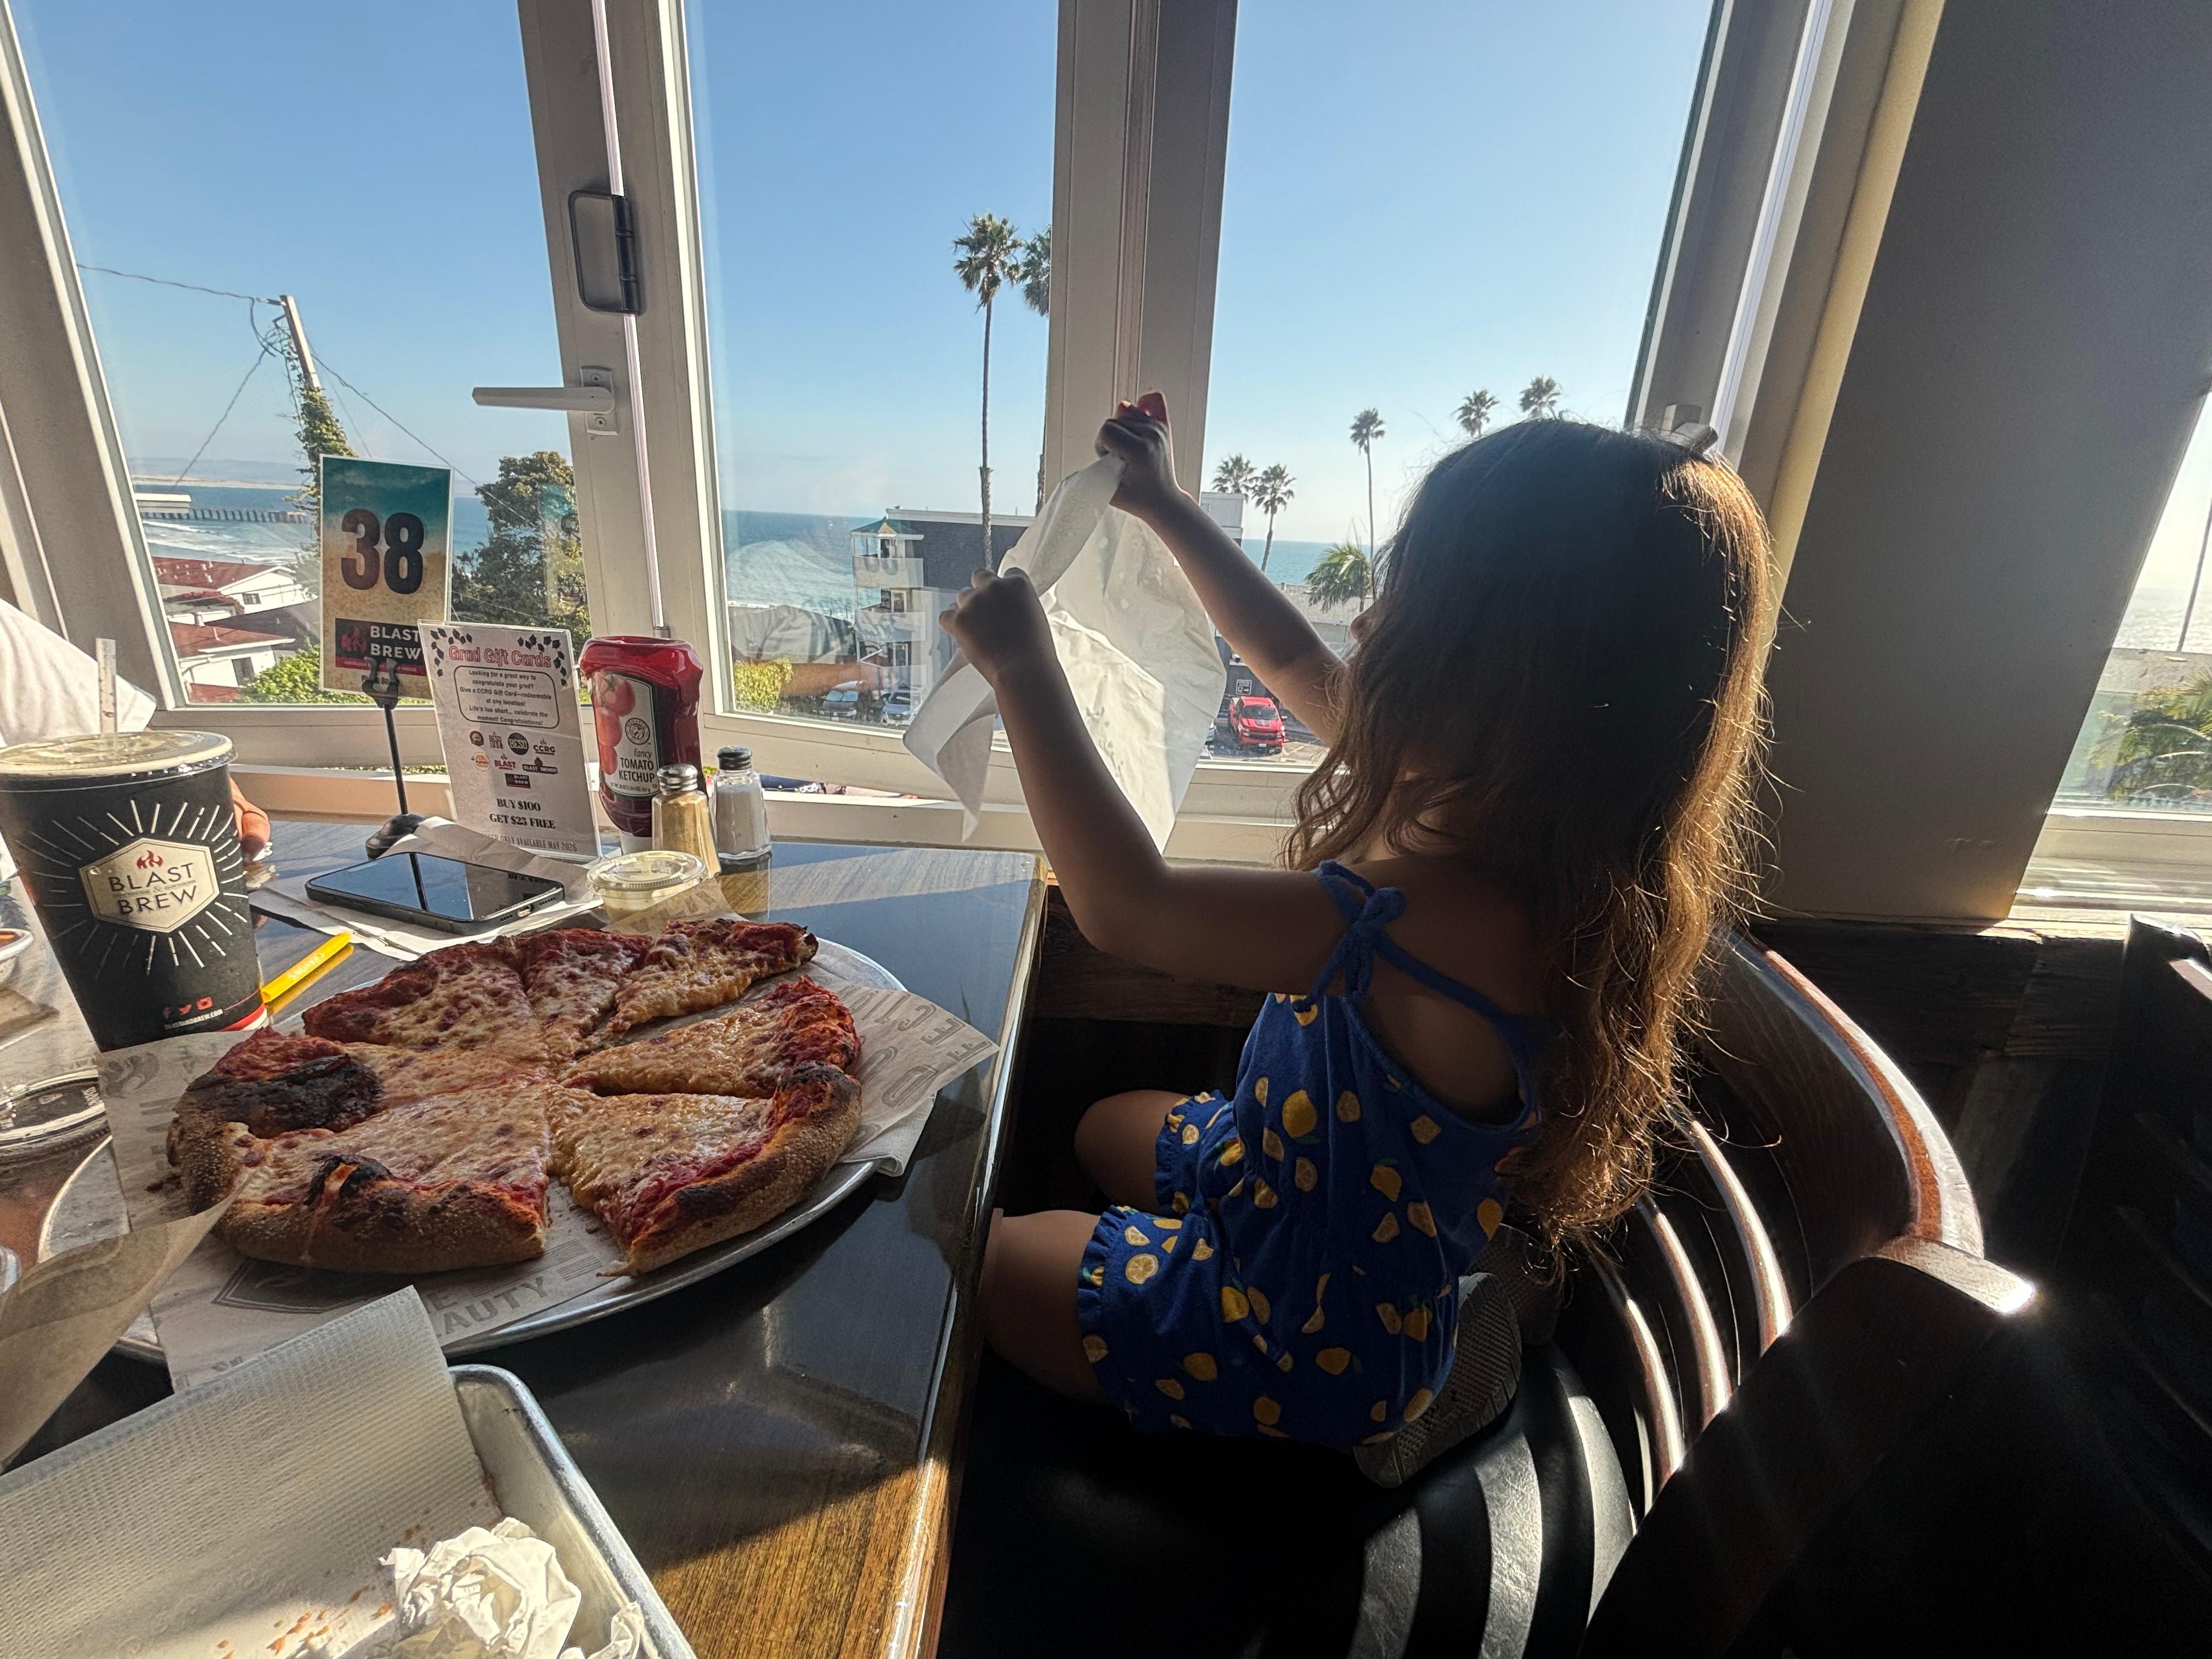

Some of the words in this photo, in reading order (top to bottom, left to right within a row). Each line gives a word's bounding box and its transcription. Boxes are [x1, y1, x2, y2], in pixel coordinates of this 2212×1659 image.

[341, 508, 425, 595] 38
[370, 625, 419, 642] BLAST
[370, 643, 422, 660] BREW
[449, 645, 481, 662] Grad
[484, 648, 509, 667] Gift
[511, 650, 552, 668] Cards
[469, 669, 489, 678] Looking
[533, 744, 556, 753] CCRG
[634, 748, 653, 759] fancy
[494, 759, 516, 769] BLAST
[619, 757, 654, 771] TOMATO
[618, 769, 655, 783] KETCHUP
[496, 798, 516, 809] BUY
[517, 801, 541, 811] $100
[489, 814, 510, 825] GET
[510, 815, 527, 826] $25
[529, 817, 556, 830] FREE
[516, 837, 547, 849] AVAILABLE
[548, 840, 560, 850] MAY
[561, 842, 578, 852] 2026
[109, 862, 194, 892] BLAST
[117, 885, 198, 915] BREW
[436, 1276, 548, 1338] AUTY
